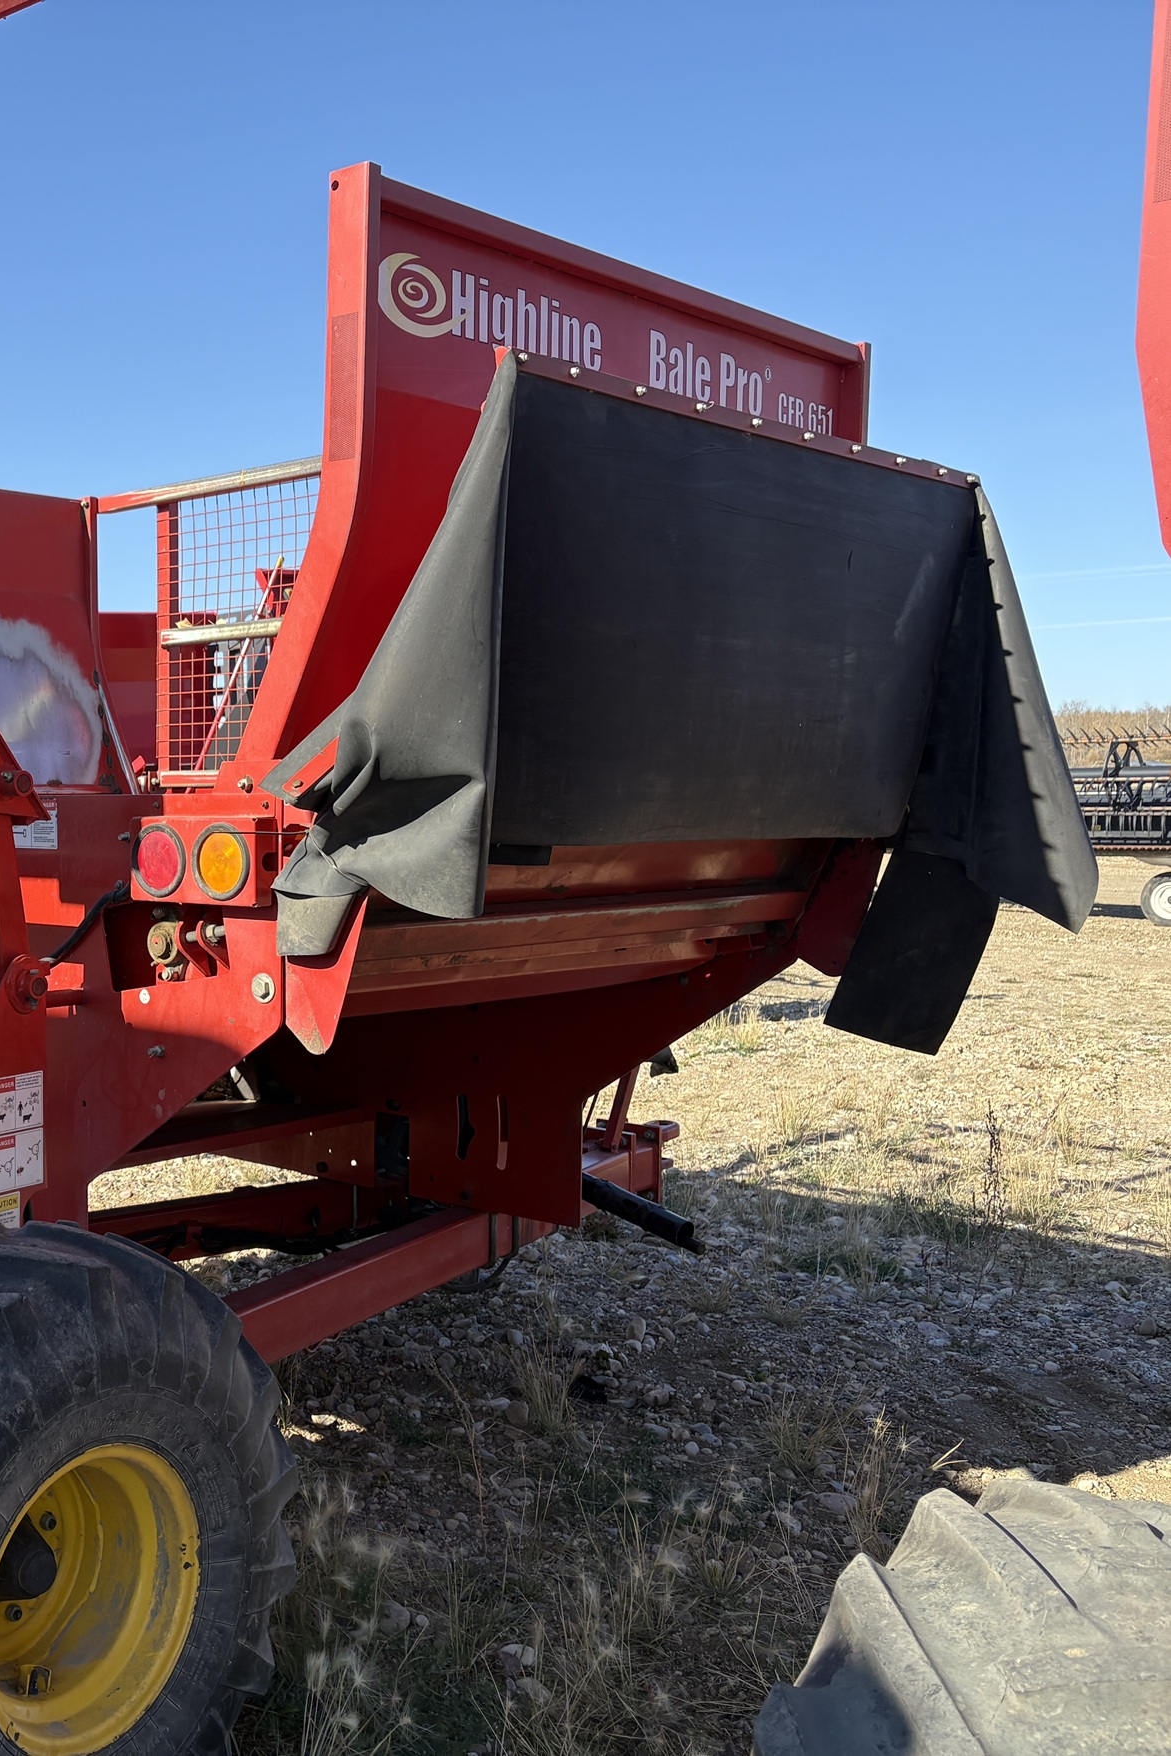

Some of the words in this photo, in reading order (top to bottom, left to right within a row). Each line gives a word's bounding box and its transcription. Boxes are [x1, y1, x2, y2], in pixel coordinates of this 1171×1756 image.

[451, 269, 602, 372] Highline
[649, 329, 711, 403] Bale
[777, 392, 804, 428] CFR
[808, 401, 833, 436] 651
